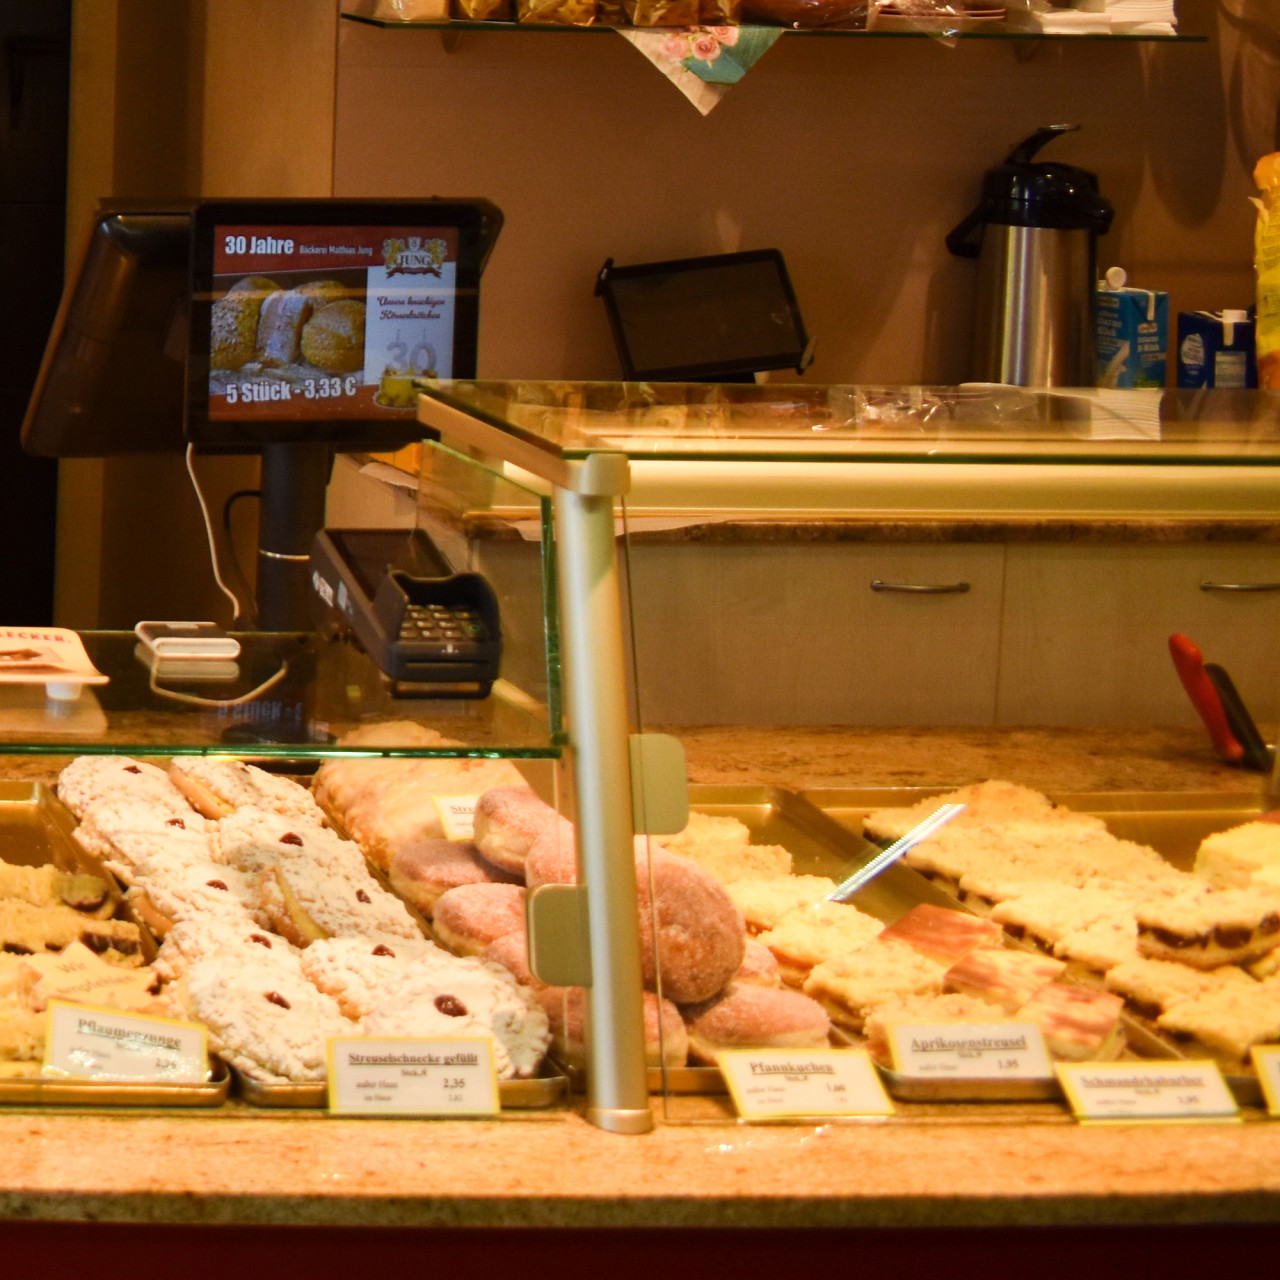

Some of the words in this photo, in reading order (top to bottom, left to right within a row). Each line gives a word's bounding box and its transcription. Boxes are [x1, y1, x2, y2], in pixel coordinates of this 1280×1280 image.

[225, 235, 246, 254] 30
[249, 236, 294, 254] Jahre
[399, 254, 431, 266] JUNG
[226, 384, 238, 403] 5
[241, 381, 291, 402] Stück
[304, 377, 341, 400] 3,33
[911, 1034, 1027, 1051] Aprikosenstreusel
[349, 1053, 440, 1063] Streuselschnecke
[443, 1053, 479, 1065] gefüllt
[749, 1061, 834, 1073] Pfannkuchen
[443, 1078, 465, 1089] 2,35
